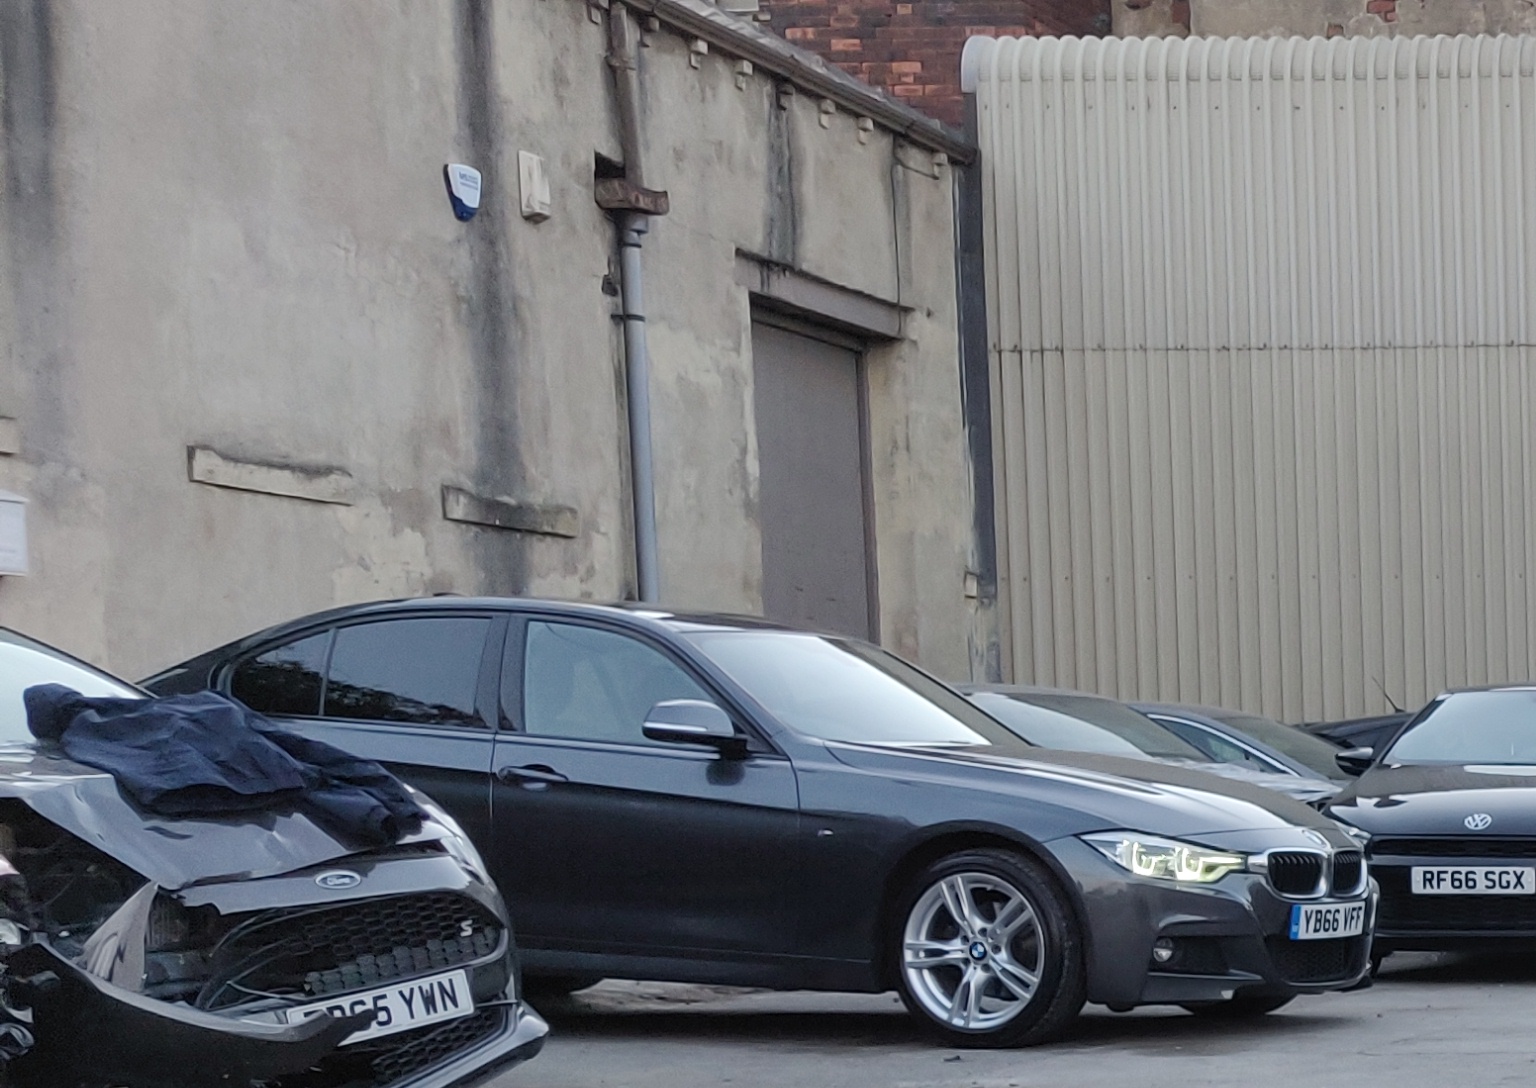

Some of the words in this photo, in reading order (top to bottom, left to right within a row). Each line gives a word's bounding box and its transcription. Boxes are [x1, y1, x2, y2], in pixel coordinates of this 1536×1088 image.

[1422, 870, 1477, 890] RF66
[1484, 870, 1526, 890] SGX
[1304, 908, 1341, 934] YB66
[1343, 905, 1363, 932] VFF
[397, 977, 460, 1020] YWN
